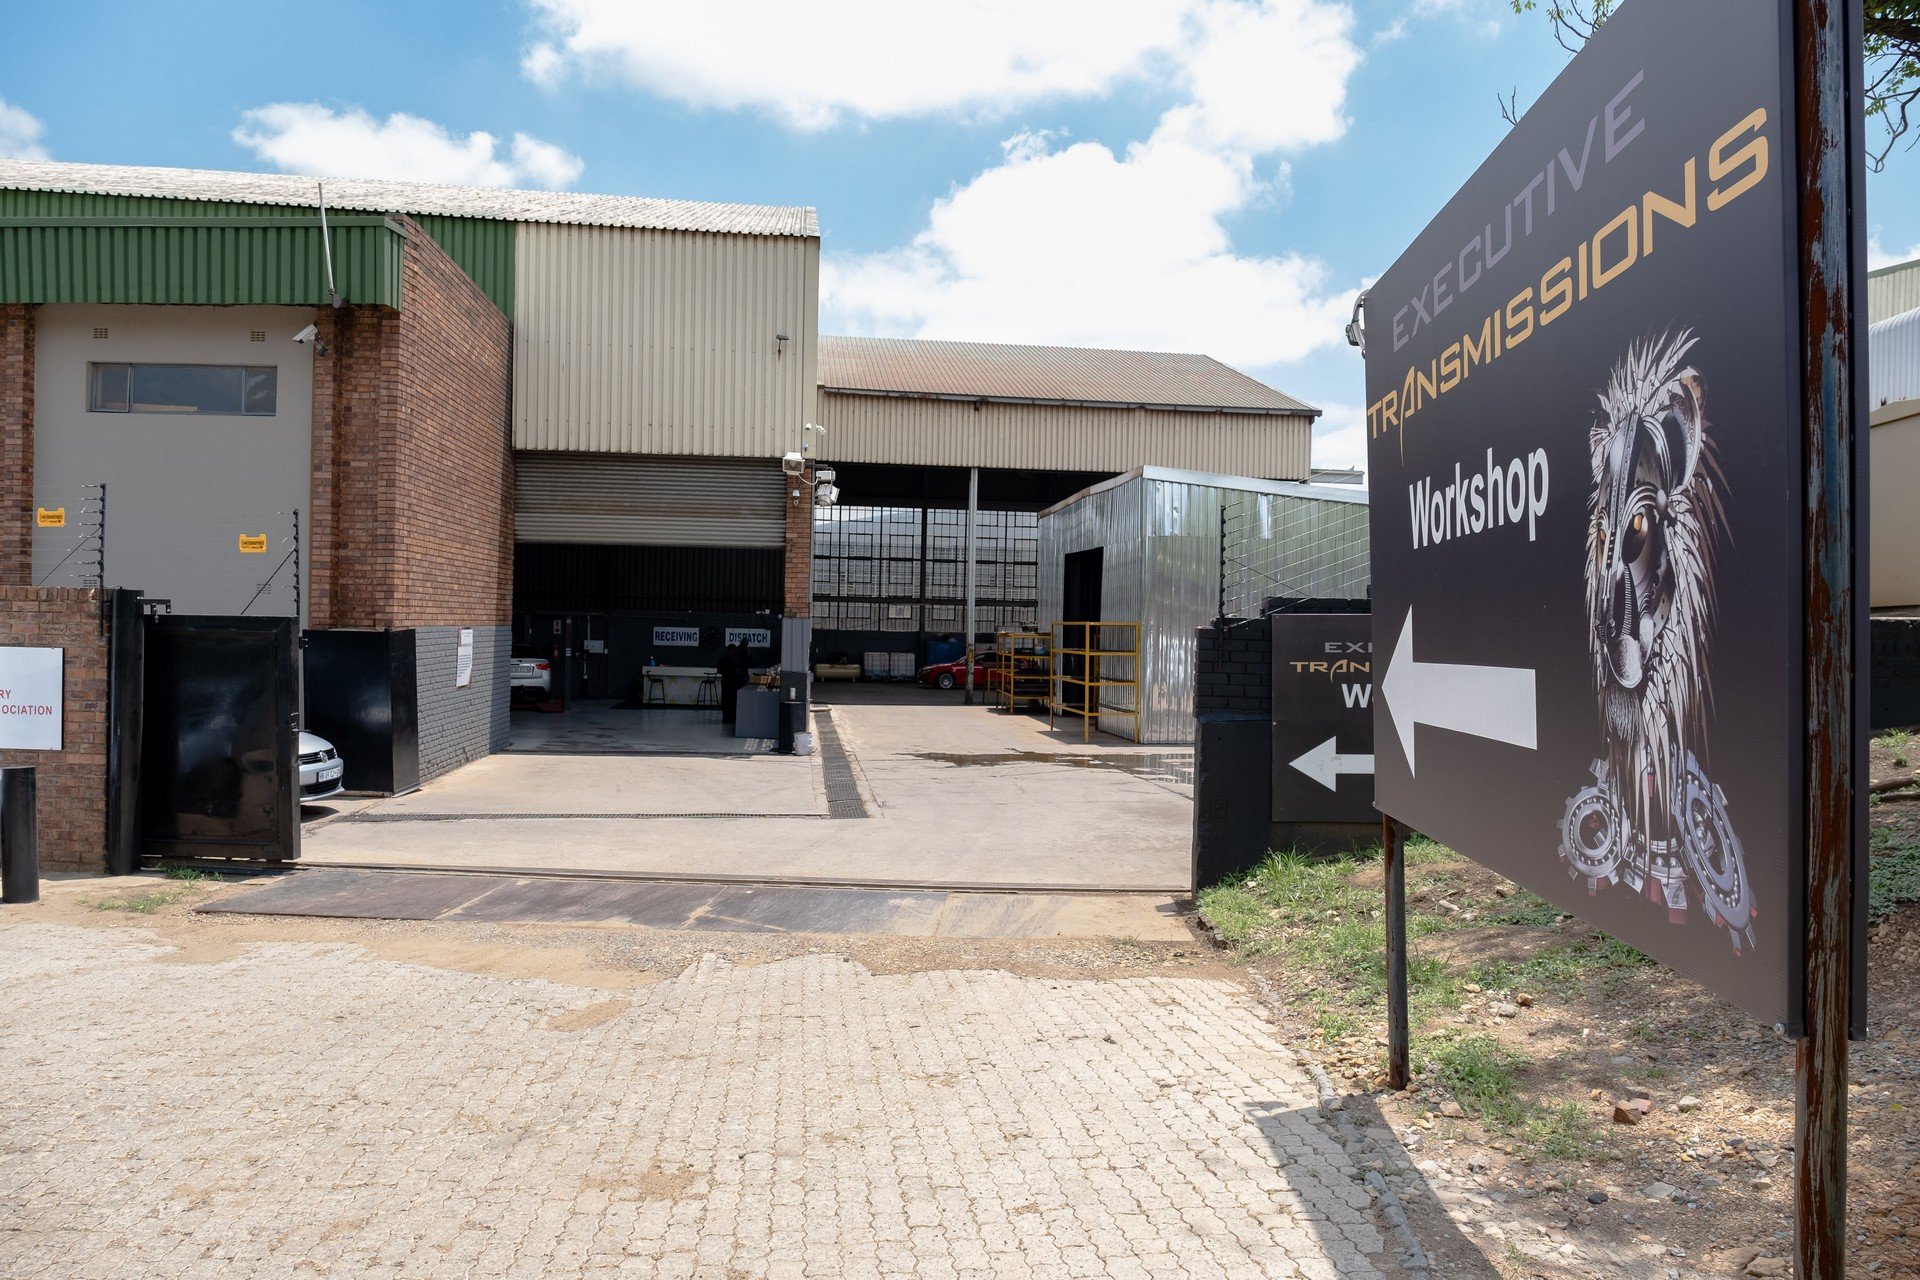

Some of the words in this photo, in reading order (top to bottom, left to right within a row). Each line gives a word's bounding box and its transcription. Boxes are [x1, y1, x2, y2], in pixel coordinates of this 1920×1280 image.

[1392, 69, 1645, 353] EXECUTIVE
[1367, 107, 1769, 466] TRANSMISSIONS
[1409, 446, 1549, 550] Workshop
[655, 631, 698, 642] RECEIVING
[729, 632, 768, 643] DISPATCH
[1, 704, 53, 715] OCIATION
